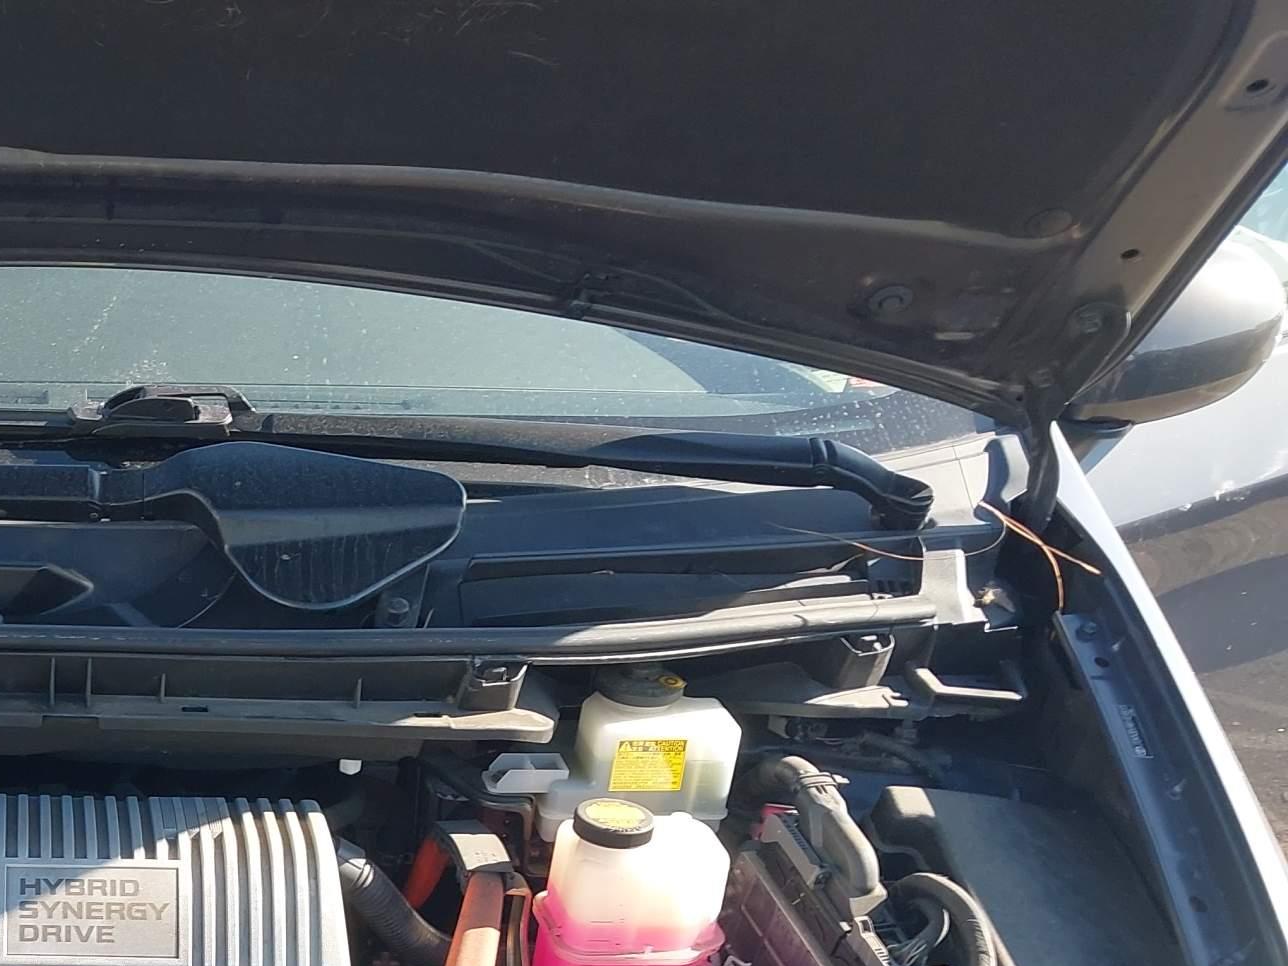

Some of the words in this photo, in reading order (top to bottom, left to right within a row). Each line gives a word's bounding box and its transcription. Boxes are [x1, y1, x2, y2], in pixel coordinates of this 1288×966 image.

[19, 878, 140, 897] HYBRID
[18, 900, 171, 921] SYNERGY
[18, 924, 116, 944] DRIVE
